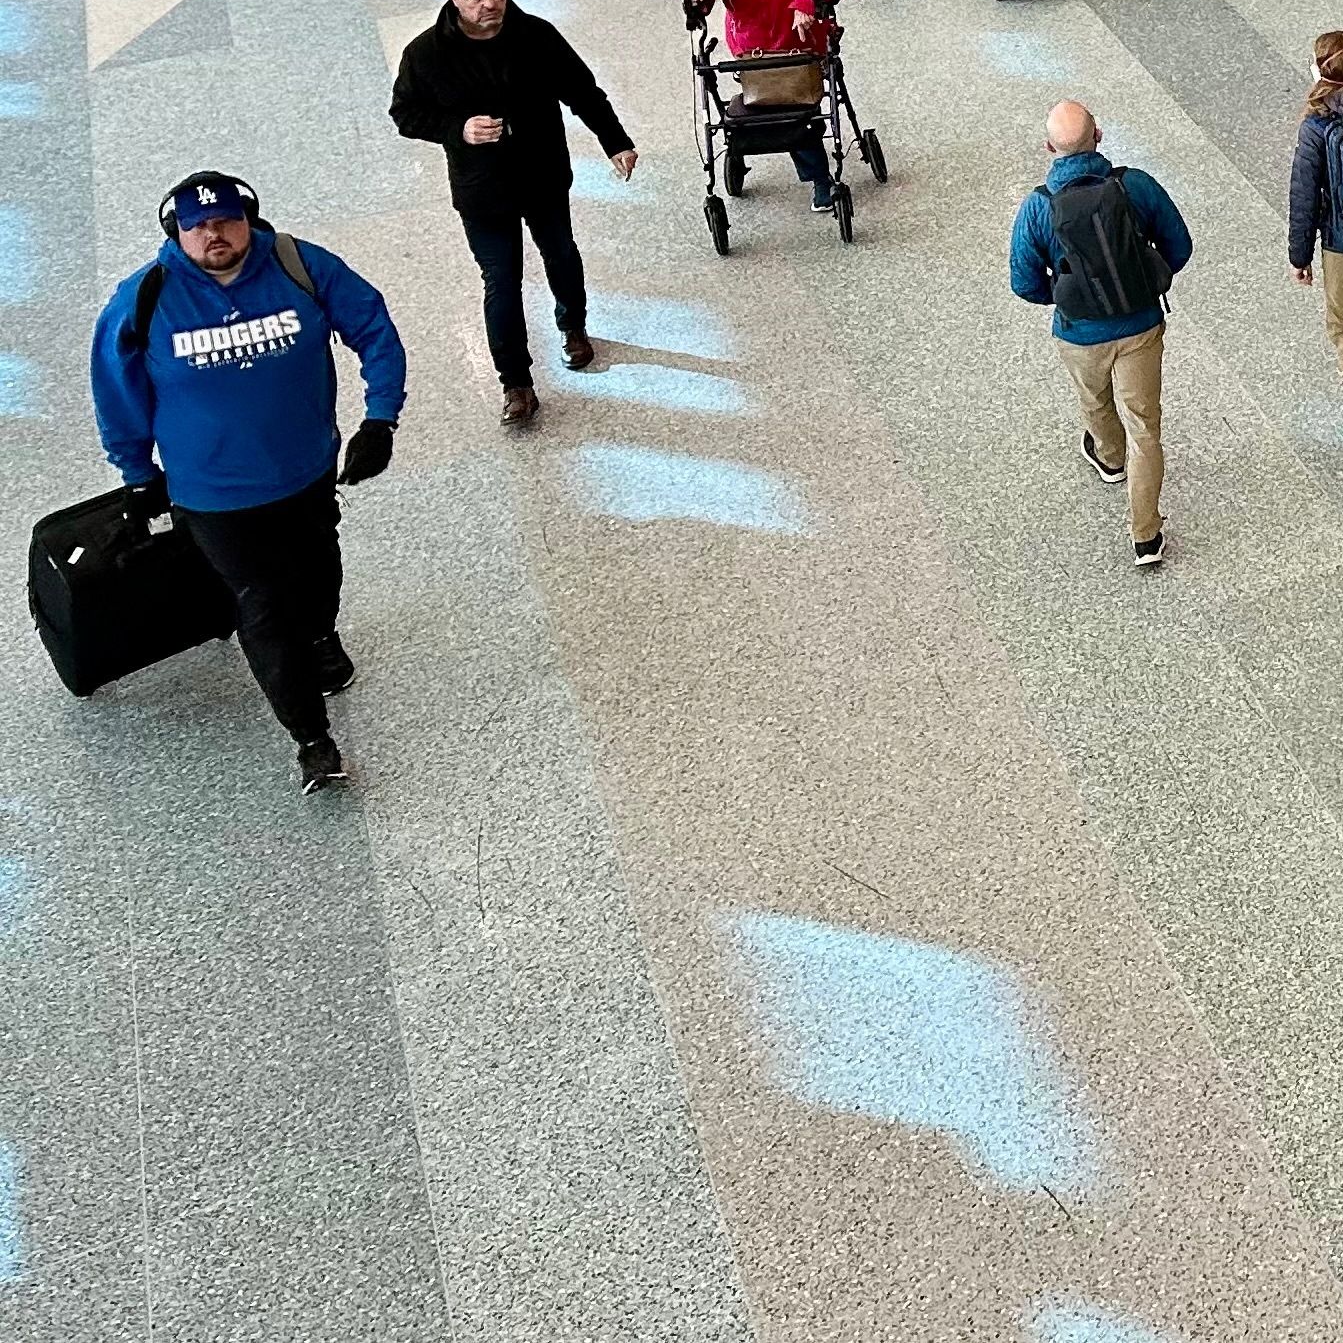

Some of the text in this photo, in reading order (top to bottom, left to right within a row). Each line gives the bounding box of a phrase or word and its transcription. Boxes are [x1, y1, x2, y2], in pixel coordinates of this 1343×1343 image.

[197, 185, 217, 206] LA
[172, 310, 301, 358] DODGERS
[211, 336, 296, 361] BASEBALL
